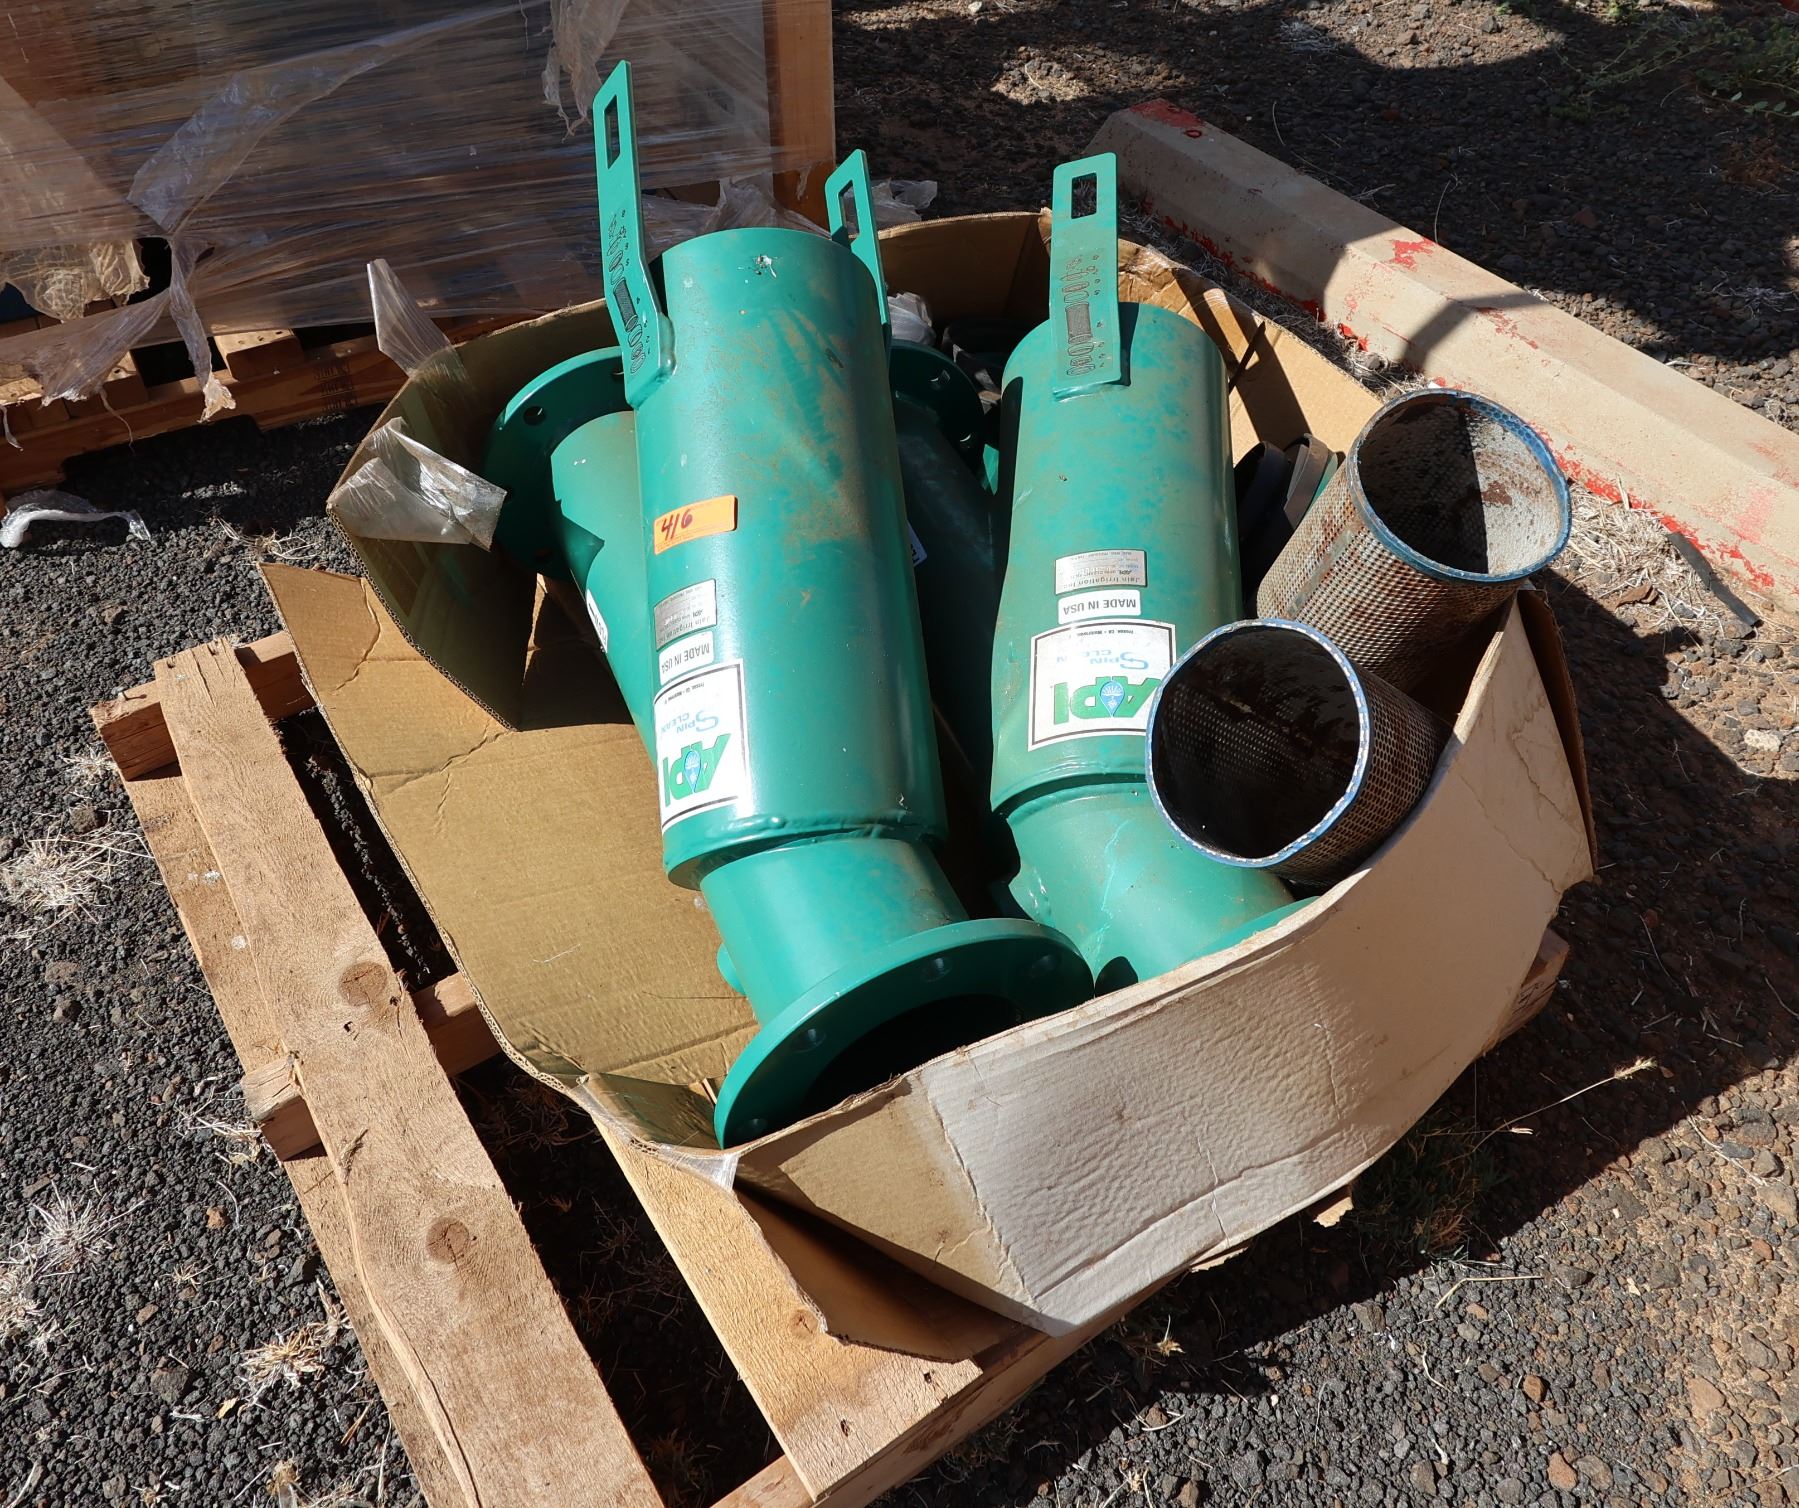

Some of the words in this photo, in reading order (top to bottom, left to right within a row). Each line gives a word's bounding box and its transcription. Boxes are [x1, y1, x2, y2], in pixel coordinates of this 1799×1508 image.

[661, 508, 693, 541] 416
[1078, 577, 1119, 586] Irrigation
[1063, 603, 1085, 615] USA
[1088, 601, 1099, 610] IN
[1103, 599, 1137, 608] MADE
[674, 654, 682, 665] IN
[684, 642, 710, 662] MADE
[1089, 651, 1150, 670] SPIN
[661, 657, 673, 674] USA
[1053, 676, 1162, 725] API
[676, 710, 718, 734] SPIN
[662, 733, 732, 808] API
